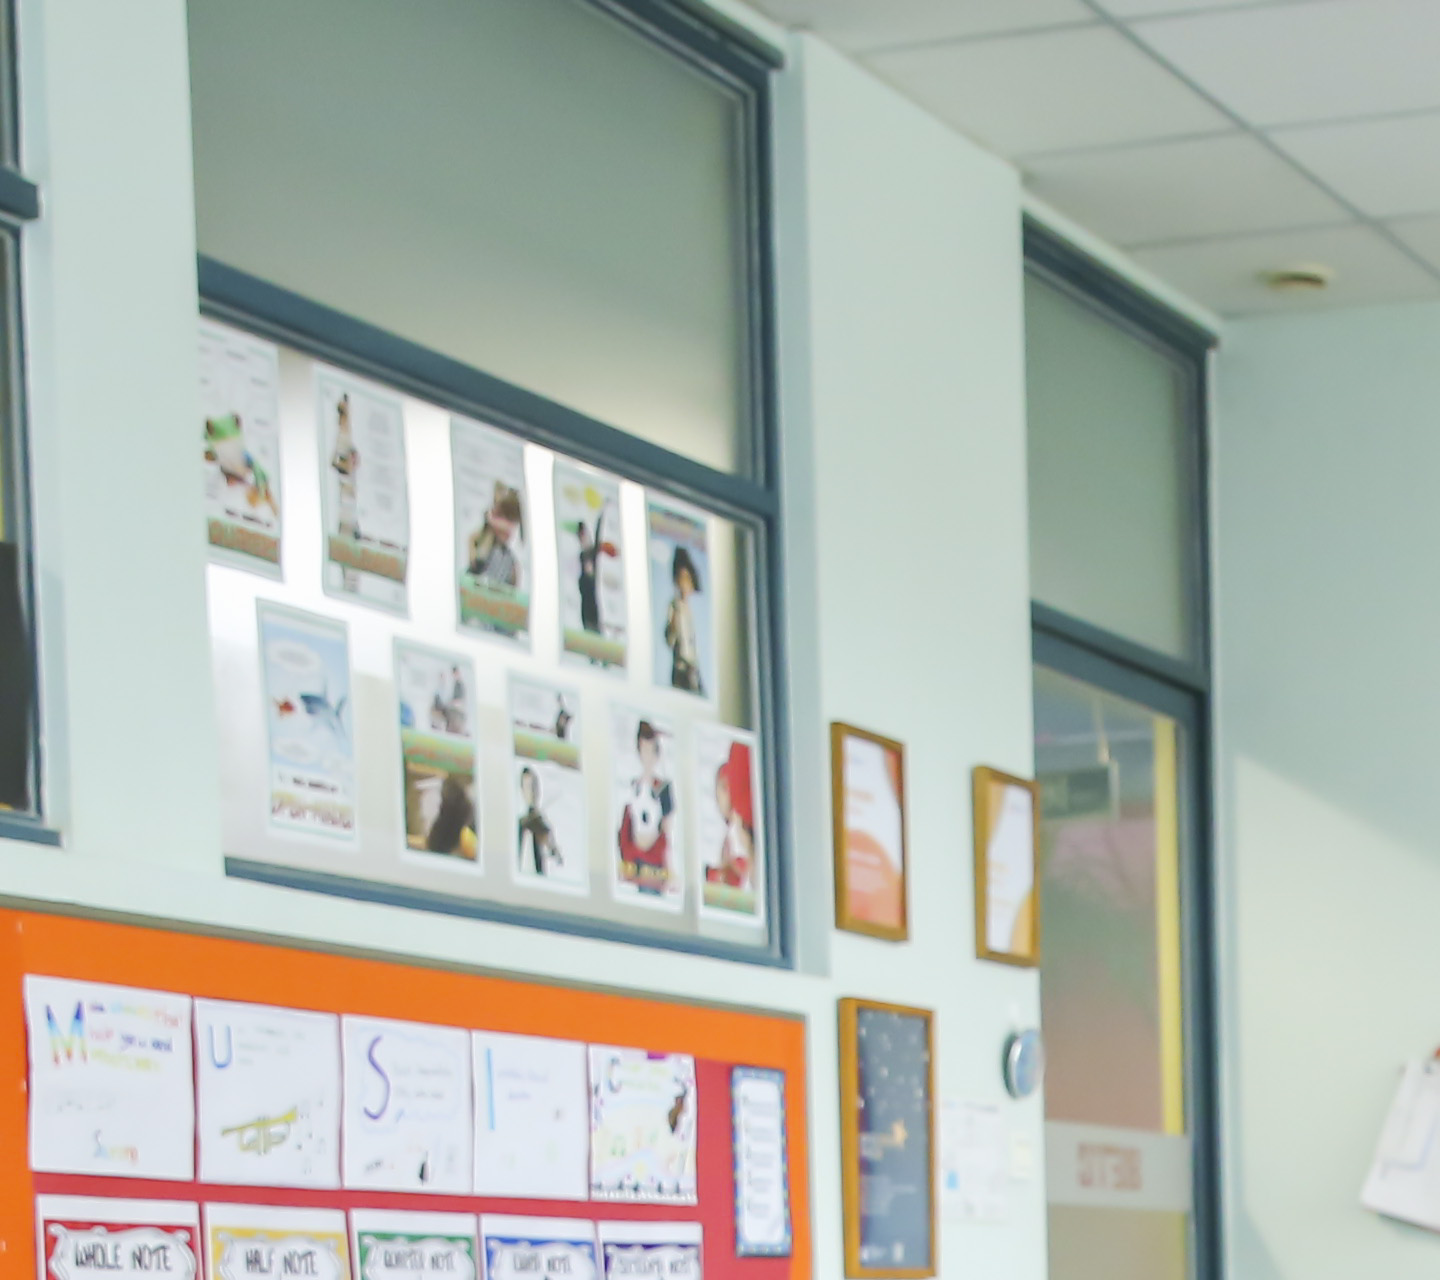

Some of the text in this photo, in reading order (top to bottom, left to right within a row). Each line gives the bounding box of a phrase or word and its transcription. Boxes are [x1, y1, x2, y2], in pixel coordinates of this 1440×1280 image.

[75, 1239, 172, 1271] WHOLE NOTE
[245, 1249, 318, 1275] HALF NOTE
